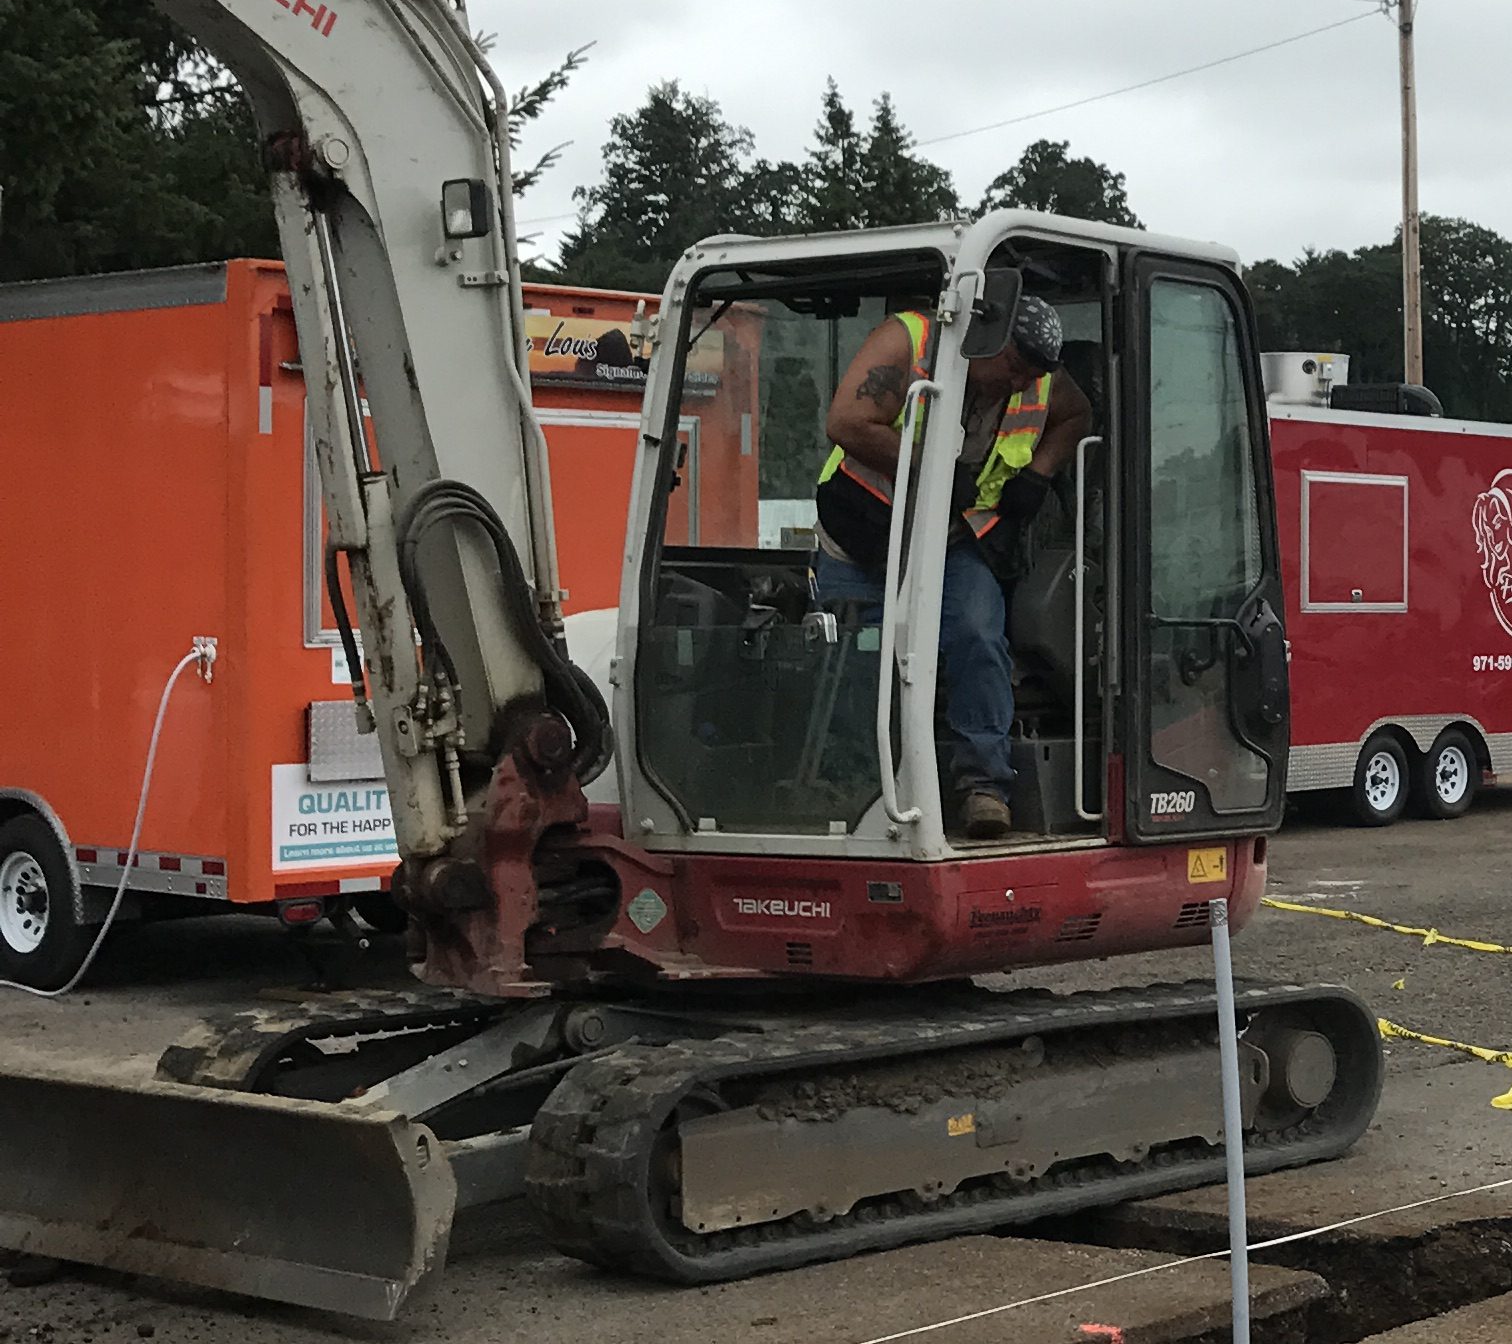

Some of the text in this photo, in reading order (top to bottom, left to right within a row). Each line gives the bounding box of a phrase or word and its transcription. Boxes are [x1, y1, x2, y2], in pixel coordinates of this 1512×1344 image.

[298, 789, 387, 814] QUALIT
[1150, 790, 1196, 814] TB260
[289, 818, 391, 836] FOR THE HAPP
